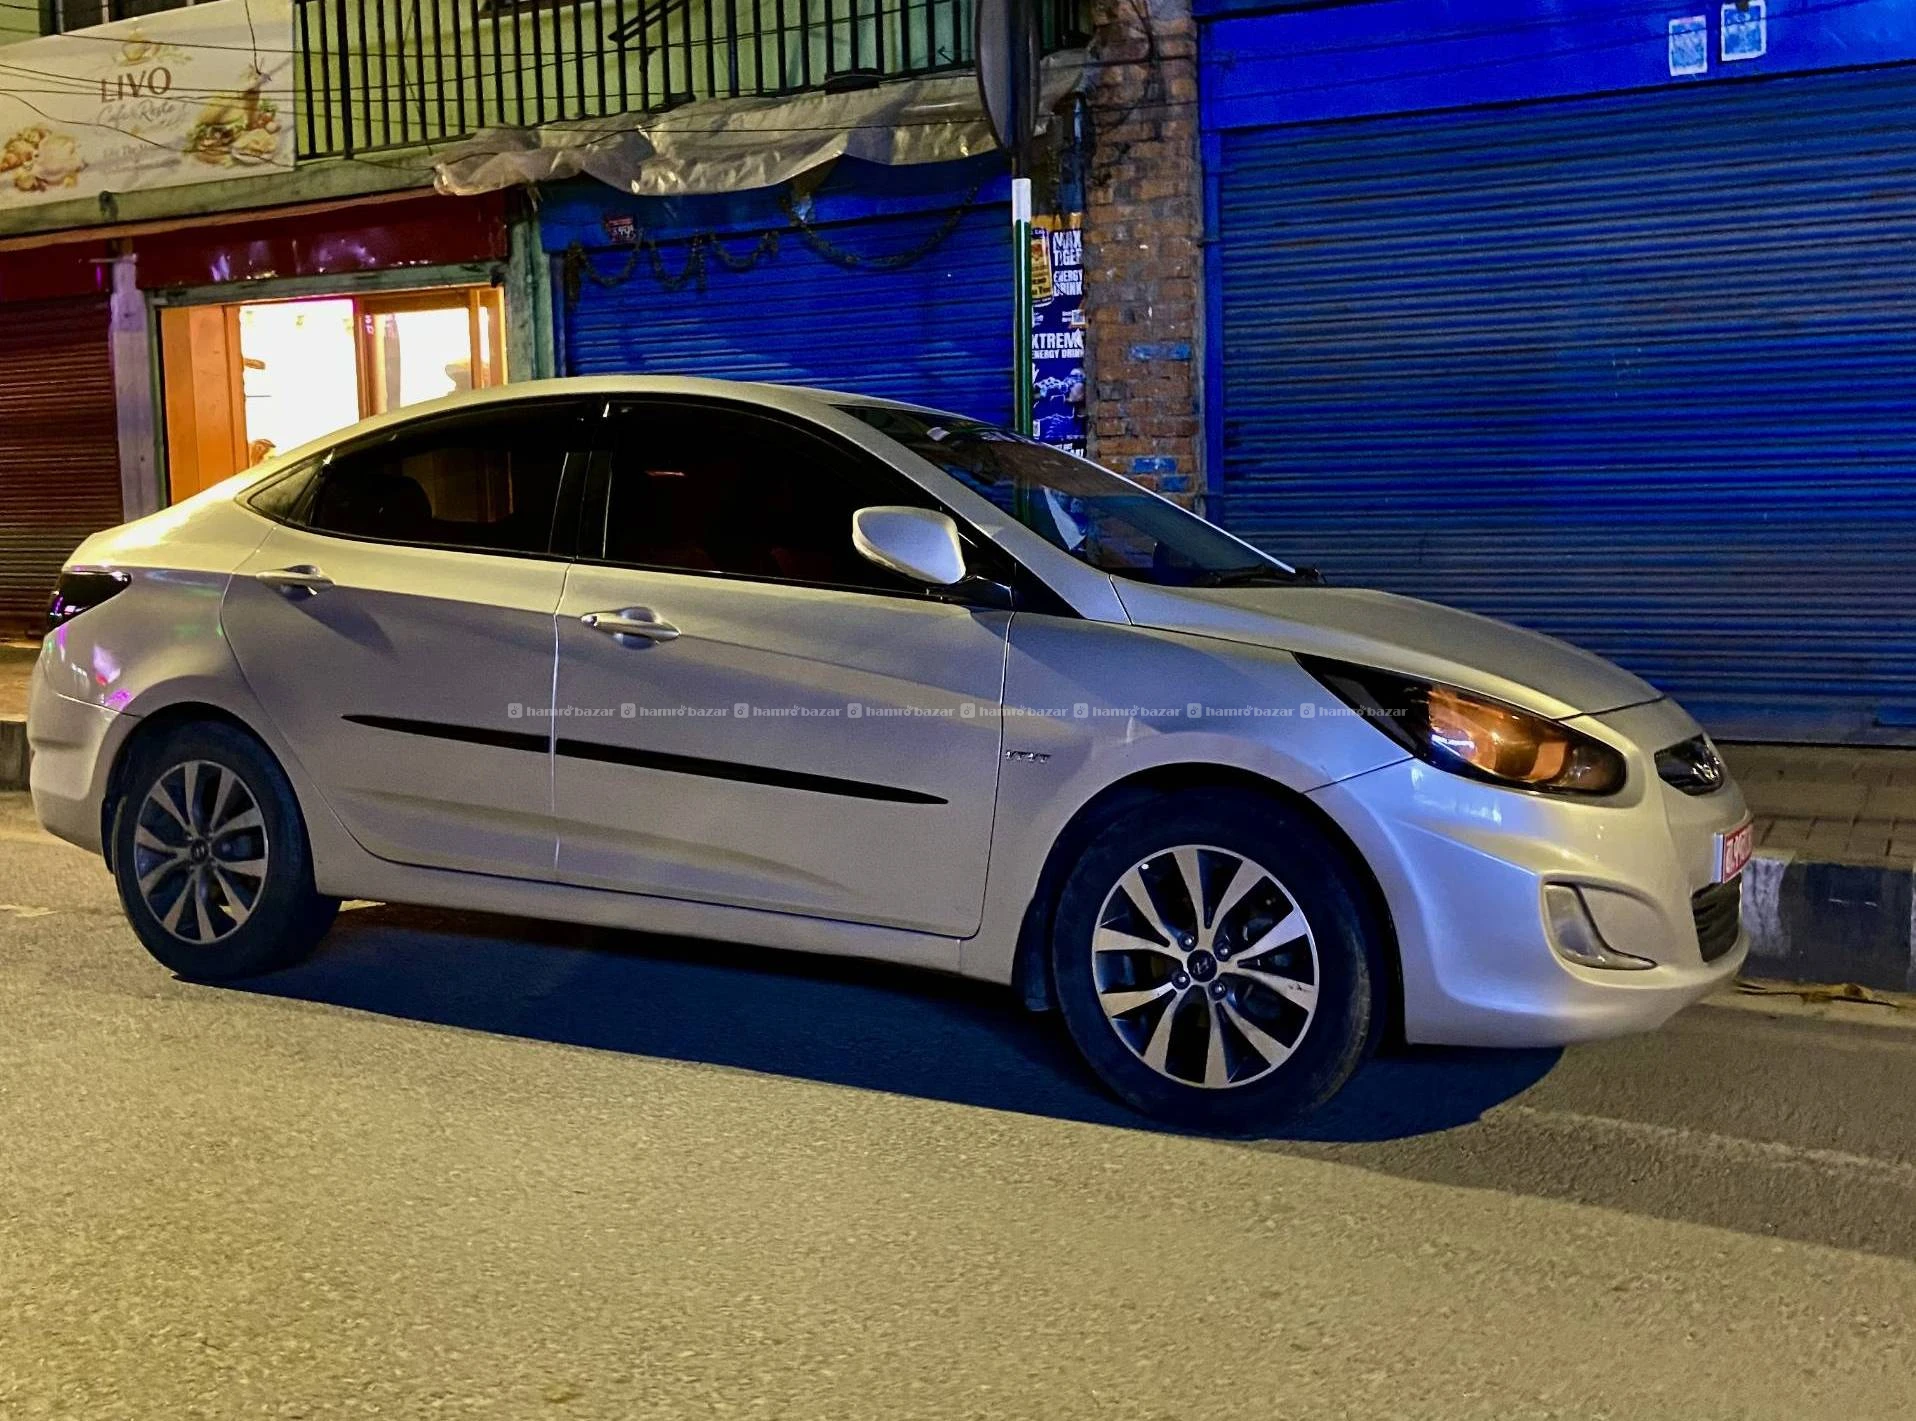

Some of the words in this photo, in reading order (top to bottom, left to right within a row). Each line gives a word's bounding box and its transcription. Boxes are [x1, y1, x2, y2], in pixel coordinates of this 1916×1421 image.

[101, 66, 172, 103] LIVO
[1053, 230, 1082, 251] MAX
[1031, 332, 1084, 349] XTREM
[1061, 349, 1084, 358] DRIN
